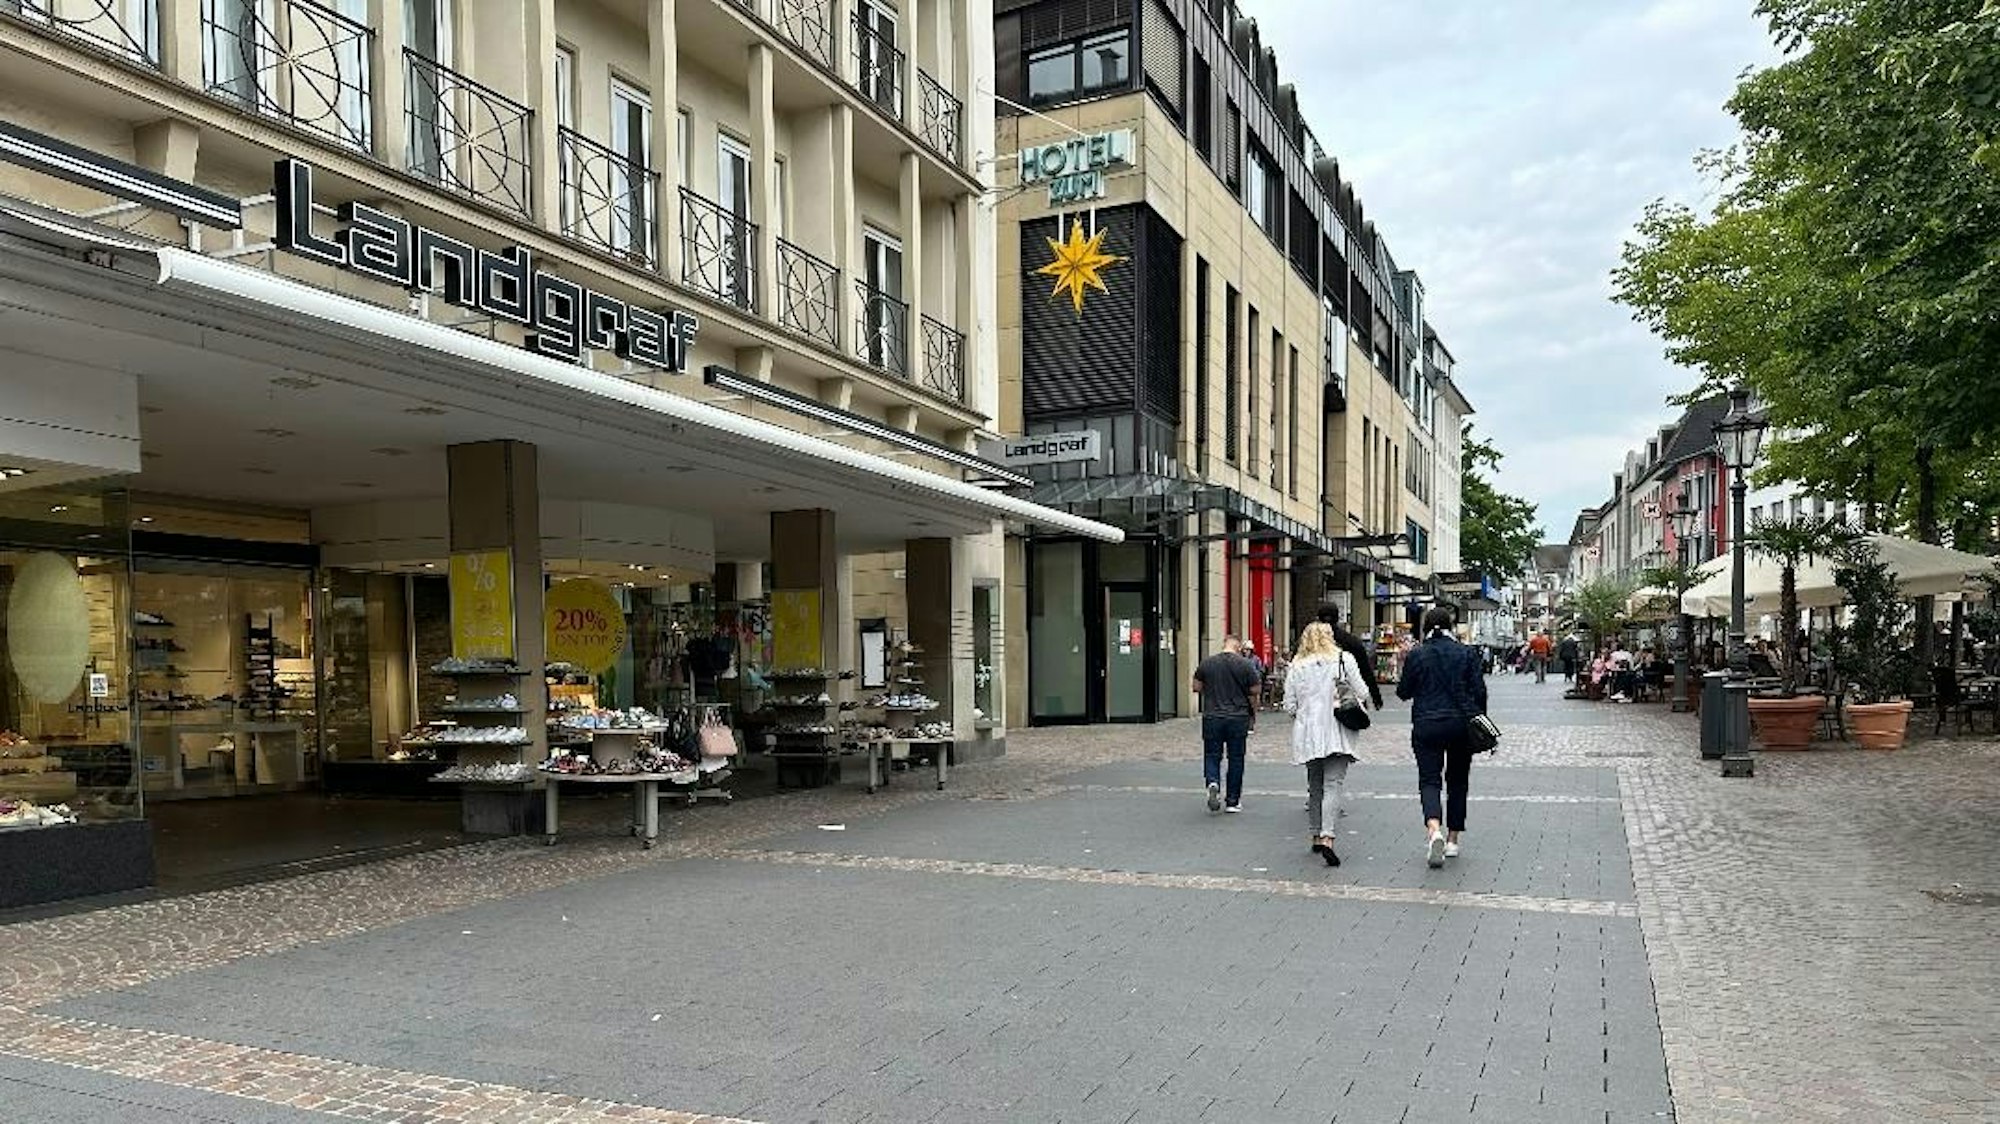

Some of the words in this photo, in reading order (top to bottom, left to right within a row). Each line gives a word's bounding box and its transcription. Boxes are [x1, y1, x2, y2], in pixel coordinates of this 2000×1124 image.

[1019, 132, 1127, 182] HOTEL
[274, 158, 700, 374] Landgraf
[1005, 437, 1089, 458] Landgraf
[555, 608, 608, 633] 20%
[555, 634, 579, 647] ON
[583, 634, 609, 646] TOP
